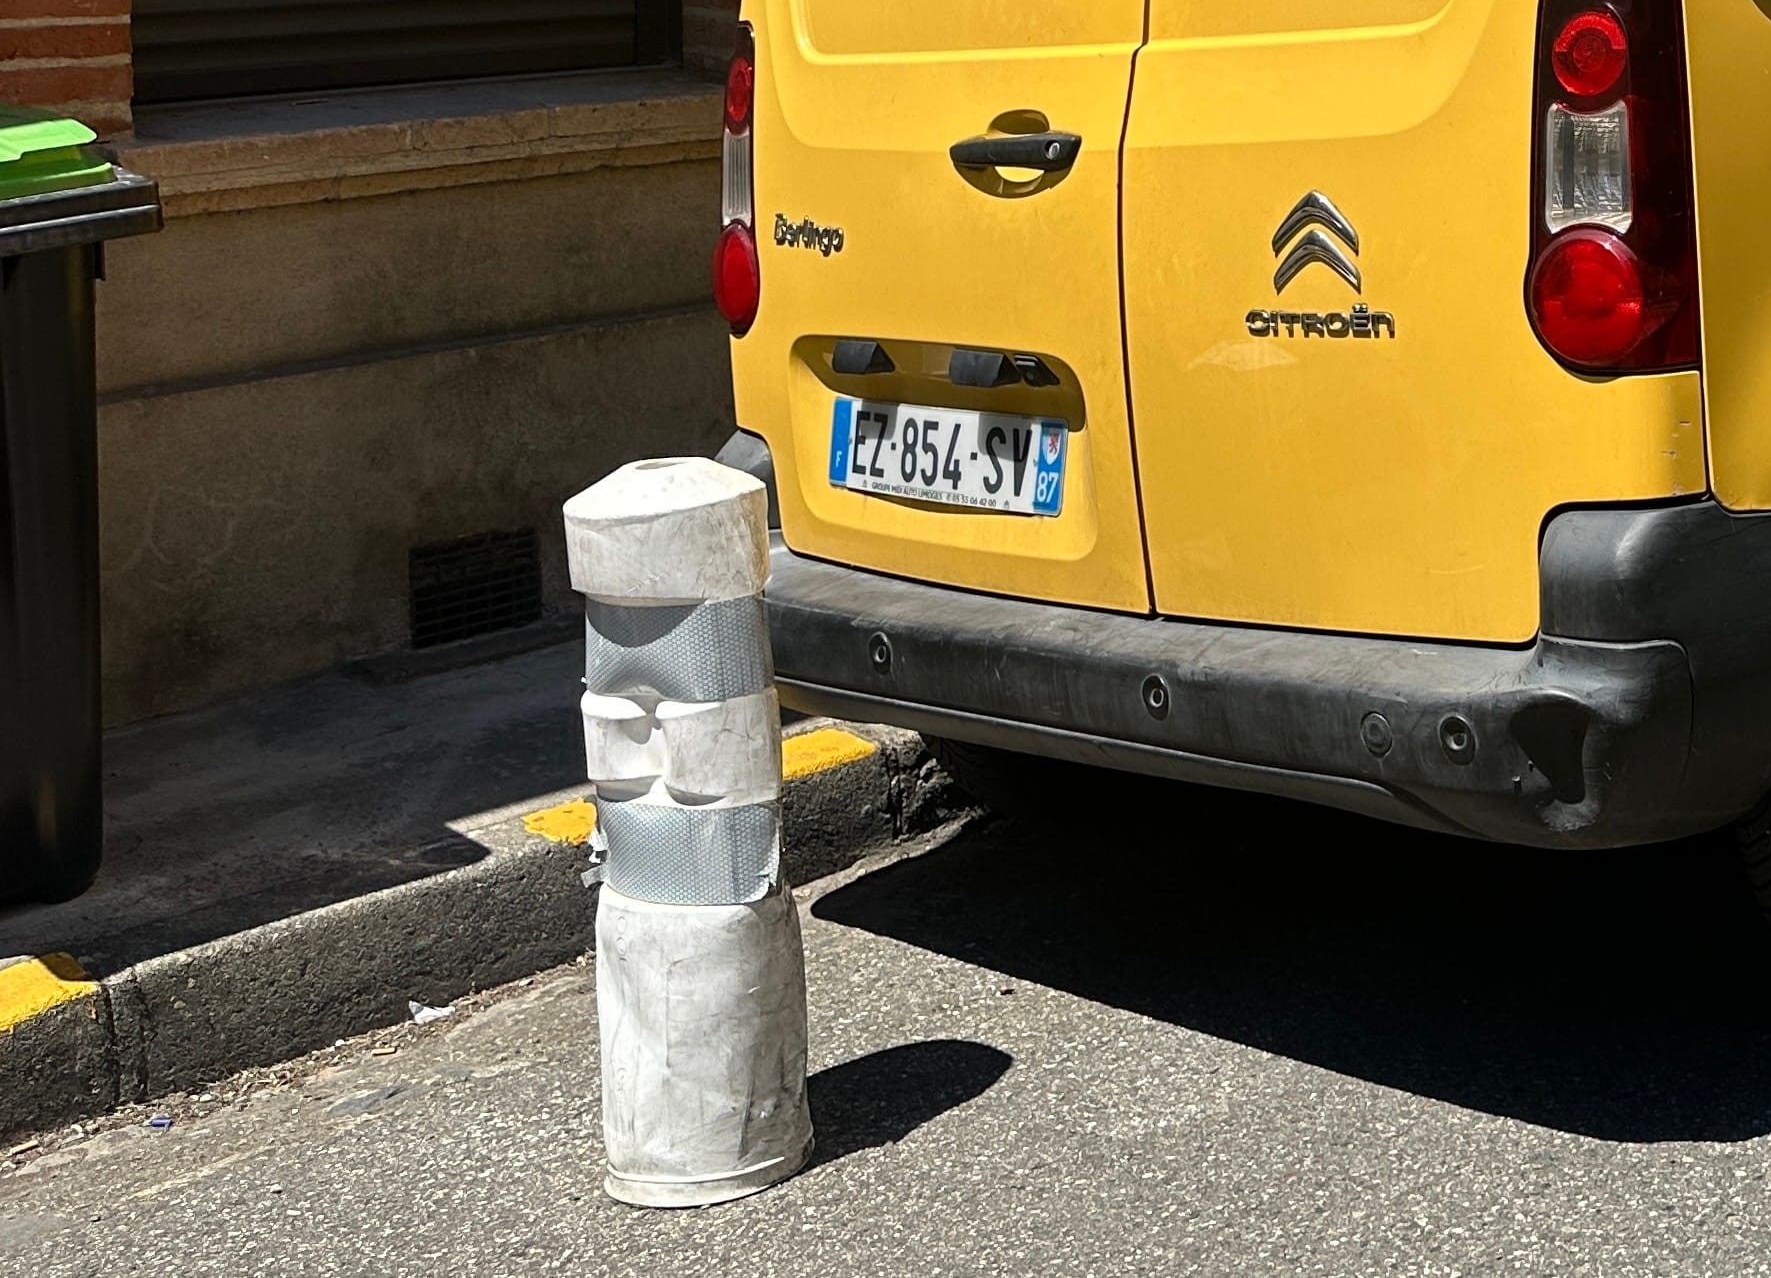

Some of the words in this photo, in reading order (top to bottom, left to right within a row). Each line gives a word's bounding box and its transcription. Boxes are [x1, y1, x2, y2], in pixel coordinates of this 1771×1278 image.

[774, 212, 844, 257] Berlingo
[1245, 303, 1396, 338] CITROËN
[835, 450, 843, 468] F
[852, 410, 1033, 497] EZ-854-SV
[1036, 471, 1060, 503] 87
